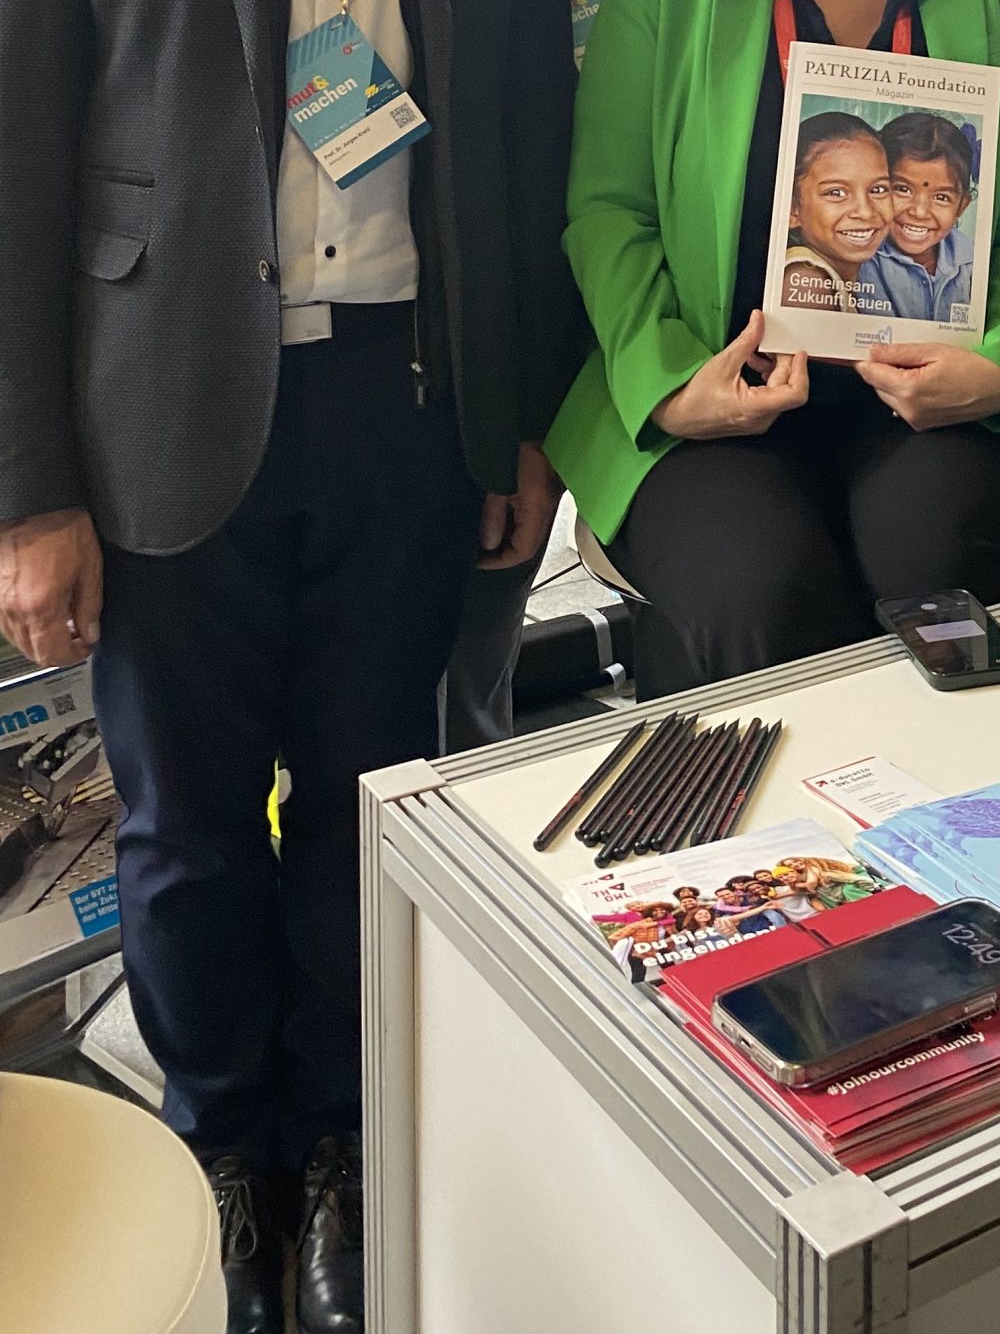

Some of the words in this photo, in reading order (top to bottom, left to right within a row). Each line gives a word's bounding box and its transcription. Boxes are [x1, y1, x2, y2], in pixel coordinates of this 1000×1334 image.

[805, 60, 892, 83] PATRIZIA
[898, 71, 986, 97] Foundation
[294, 77, 358, 123] machen
[876, 87, 914, 100] Magazin
[789, 272, 875, 294] Gemeinsam
[788, 287, 844, 307] Zukunft
[848, 293, 892, 311] bauen
[592, 889, 610, 898] TH
[604, 892, 633, 903] OWL
[634, 940, 667, 954] Du
[671, 927, 718, 945] bist
[827, 1031, 985, 1096] #joinourcommunity
